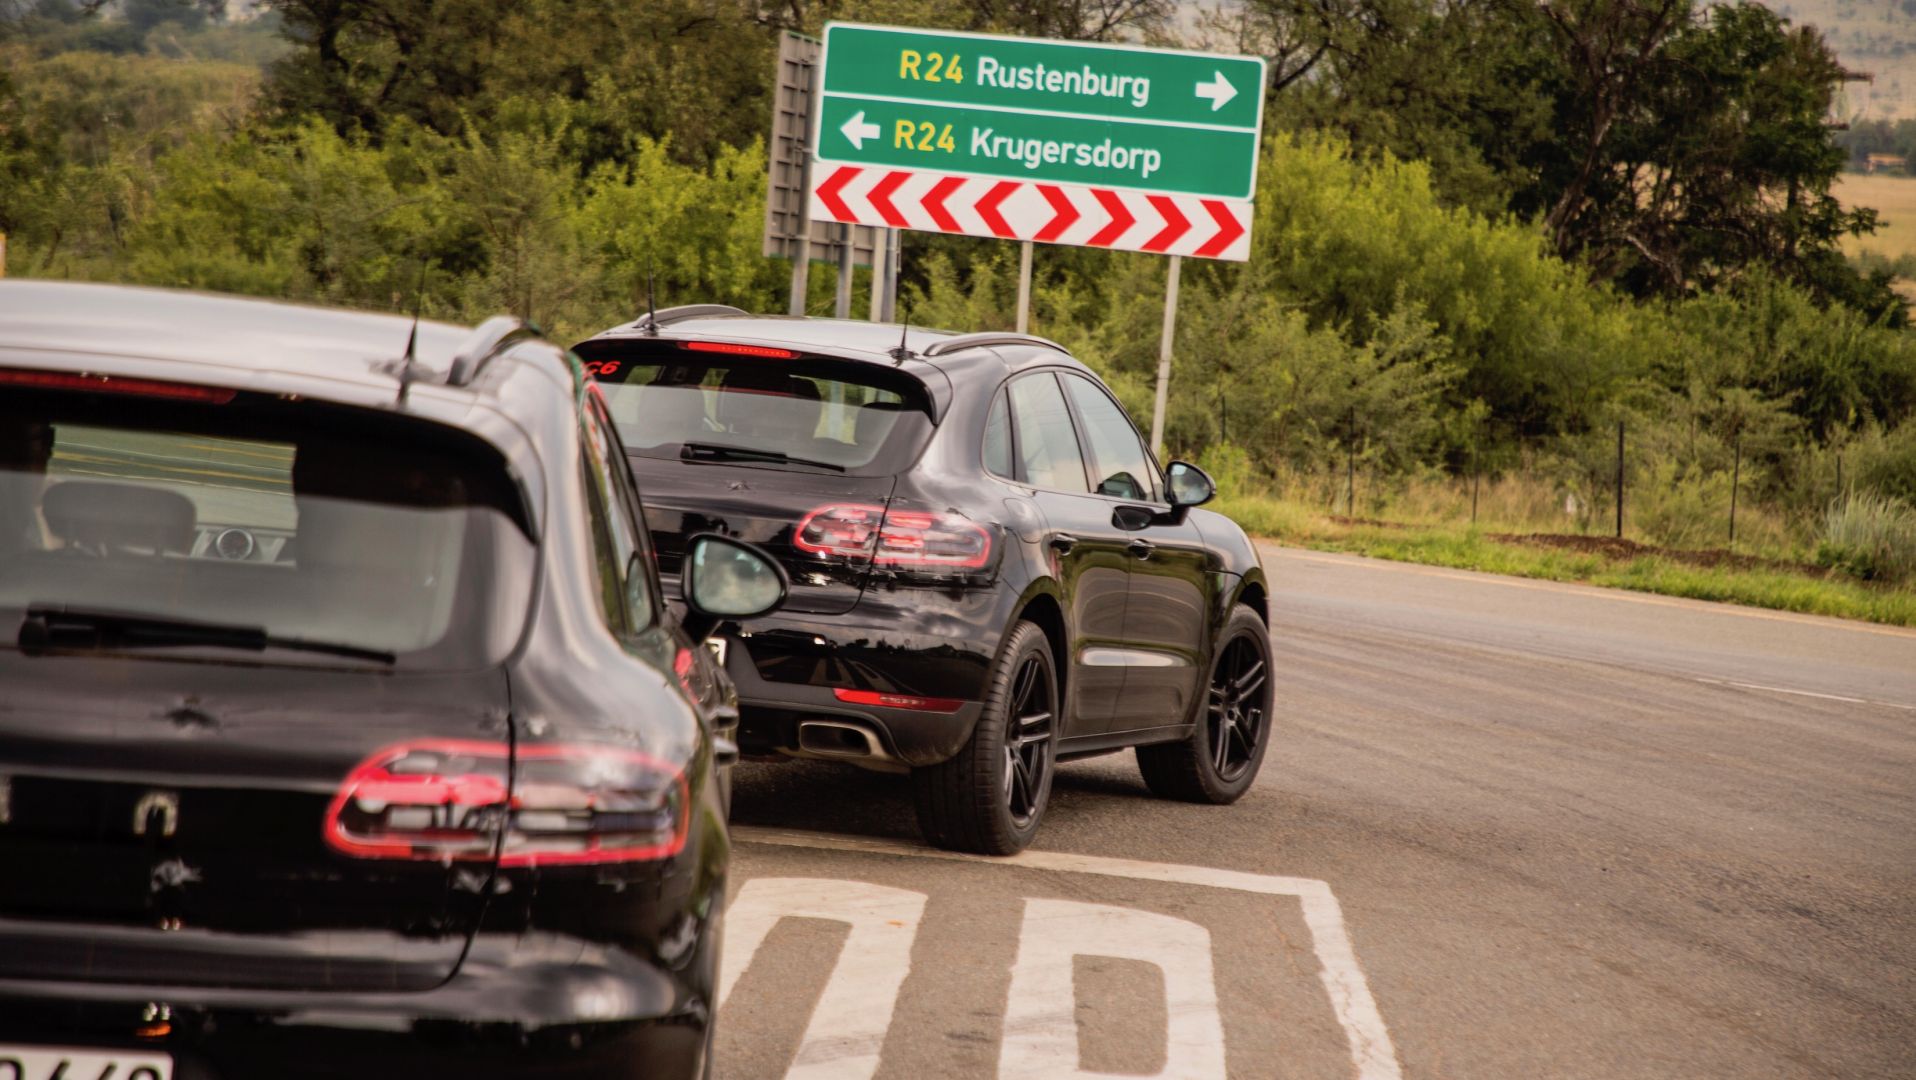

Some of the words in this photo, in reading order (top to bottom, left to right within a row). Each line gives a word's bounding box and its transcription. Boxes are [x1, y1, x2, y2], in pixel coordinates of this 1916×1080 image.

[900, 49, 964, 84] R24
[977, 56, 1150, 107] Rustenburg
[894, 119, 955, 153] R24
[970, 127, 1161, 179] Krugersdorp
